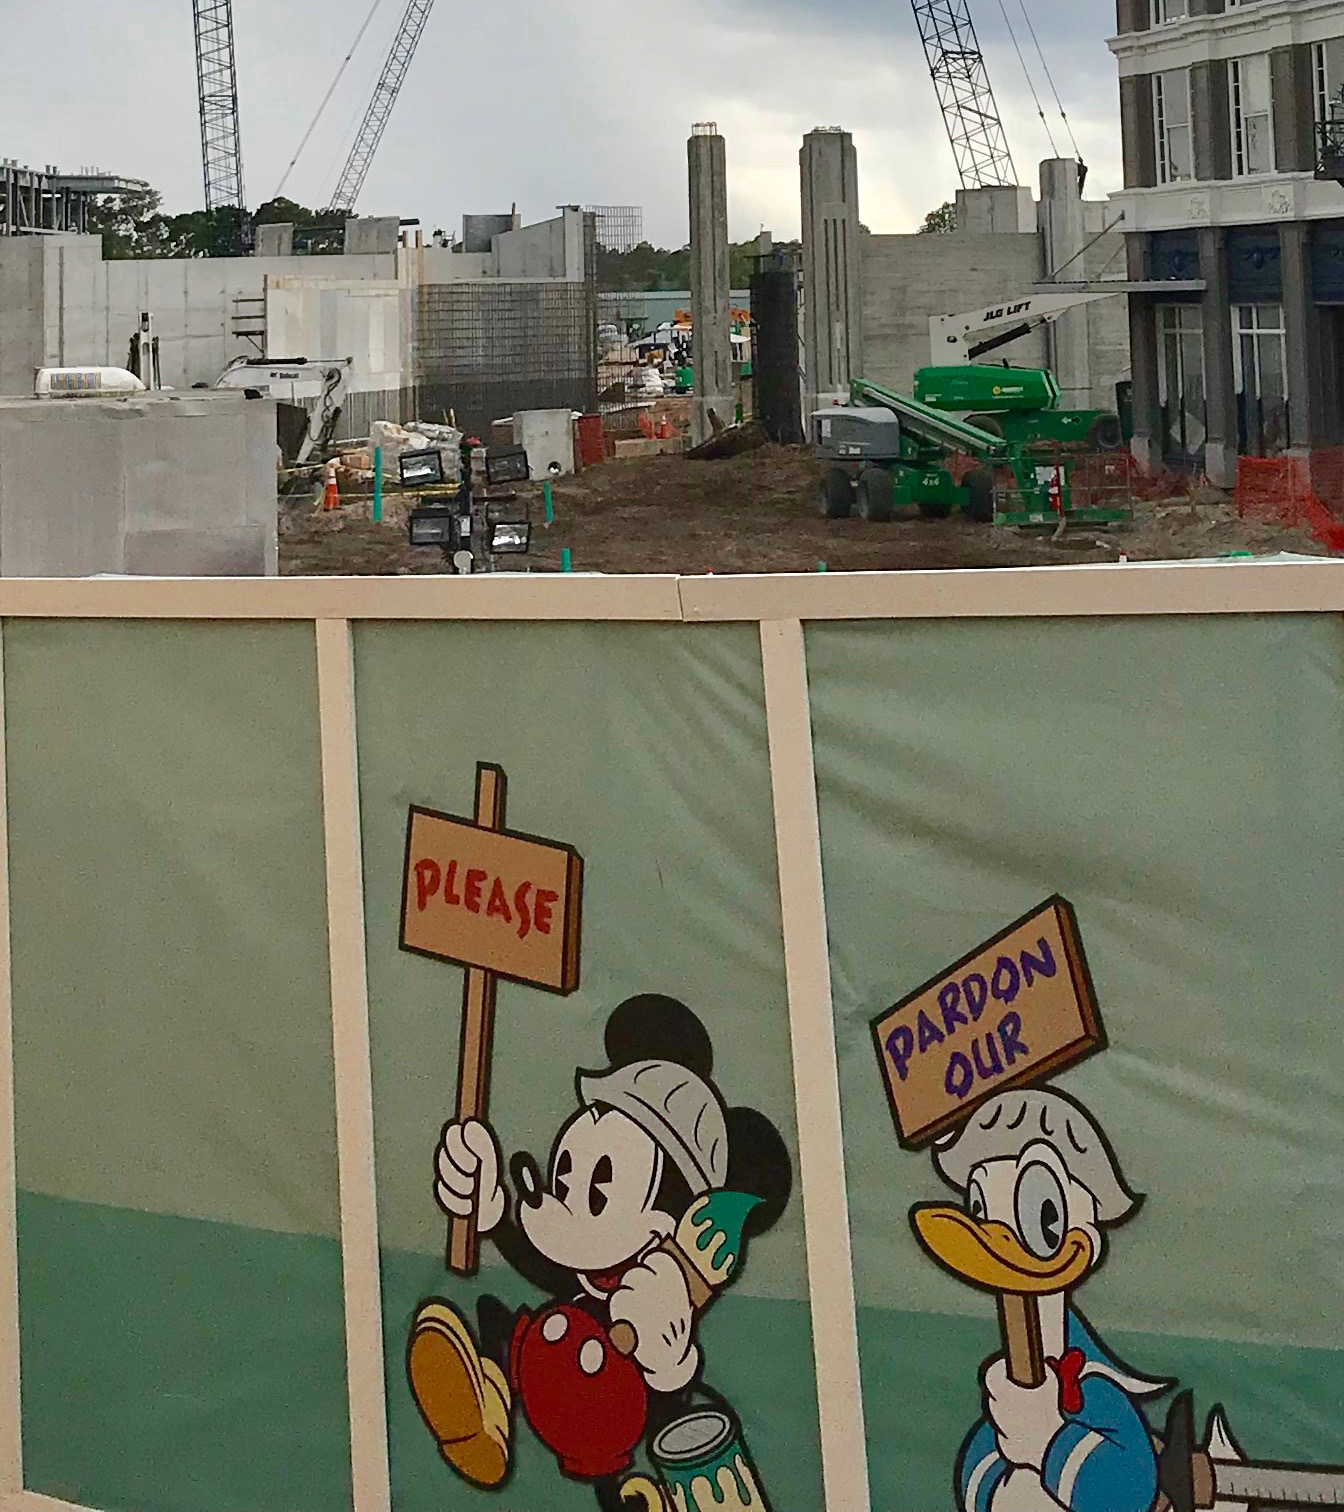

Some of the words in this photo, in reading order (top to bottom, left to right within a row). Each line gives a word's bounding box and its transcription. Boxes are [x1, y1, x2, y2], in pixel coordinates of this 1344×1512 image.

[983, 308, 1004, 322] JLG
[1006, 301, 1031, 316] LIFT
[414, 858, 560, 940] PLEASE
[885, 936, 1057, 1081] PARDON
[944, 1011, 1030, 1099] OUR
